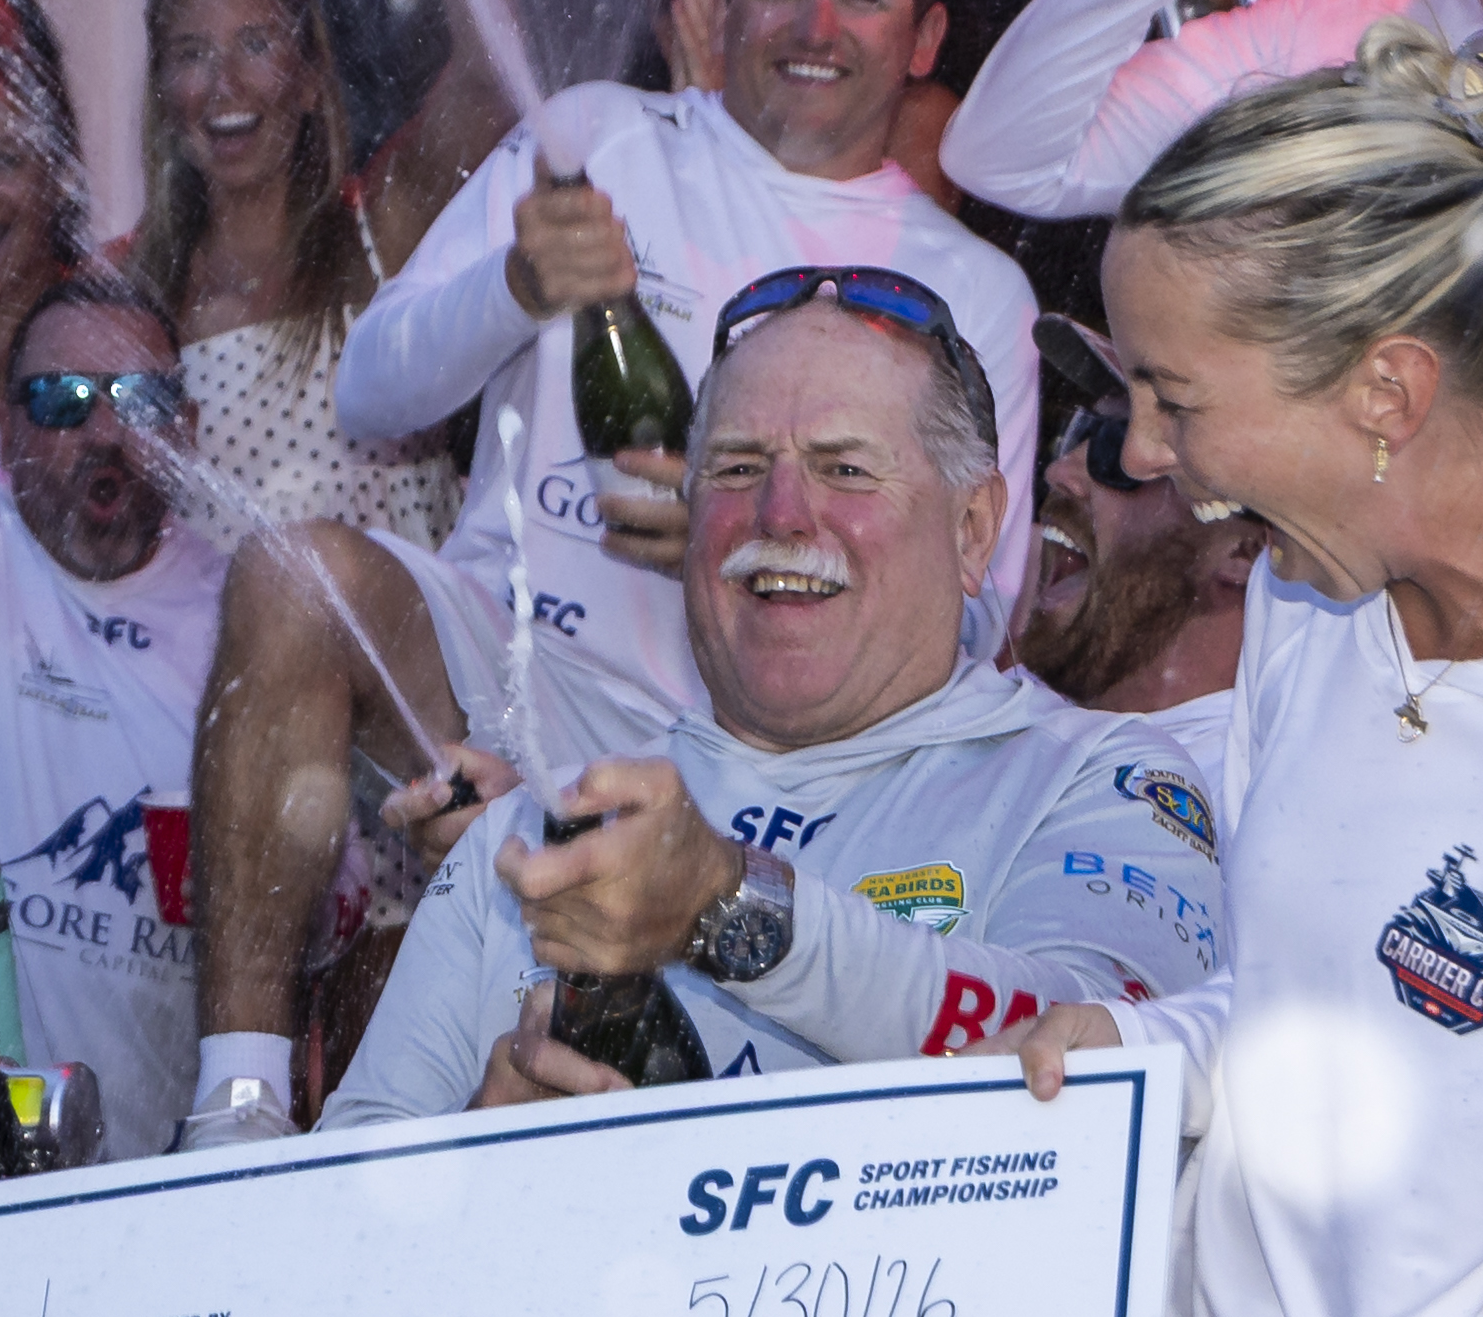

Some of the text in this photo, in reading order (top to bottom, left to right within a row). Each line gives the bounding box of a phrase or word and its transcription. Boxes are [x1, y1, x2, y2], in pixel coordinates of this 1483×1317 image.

[864, 877, 957, 899] EA BIRDS
[916, 896, 943, 905] CLUB
[1381, 928, 1473, 999] CARRIER
[858, 1150, 1058, 1183] SPORT FISHING
[679, 1158, 841, 1236] SFC
[853, 1176, 1059, 1212] CHAMPIONSHIP
